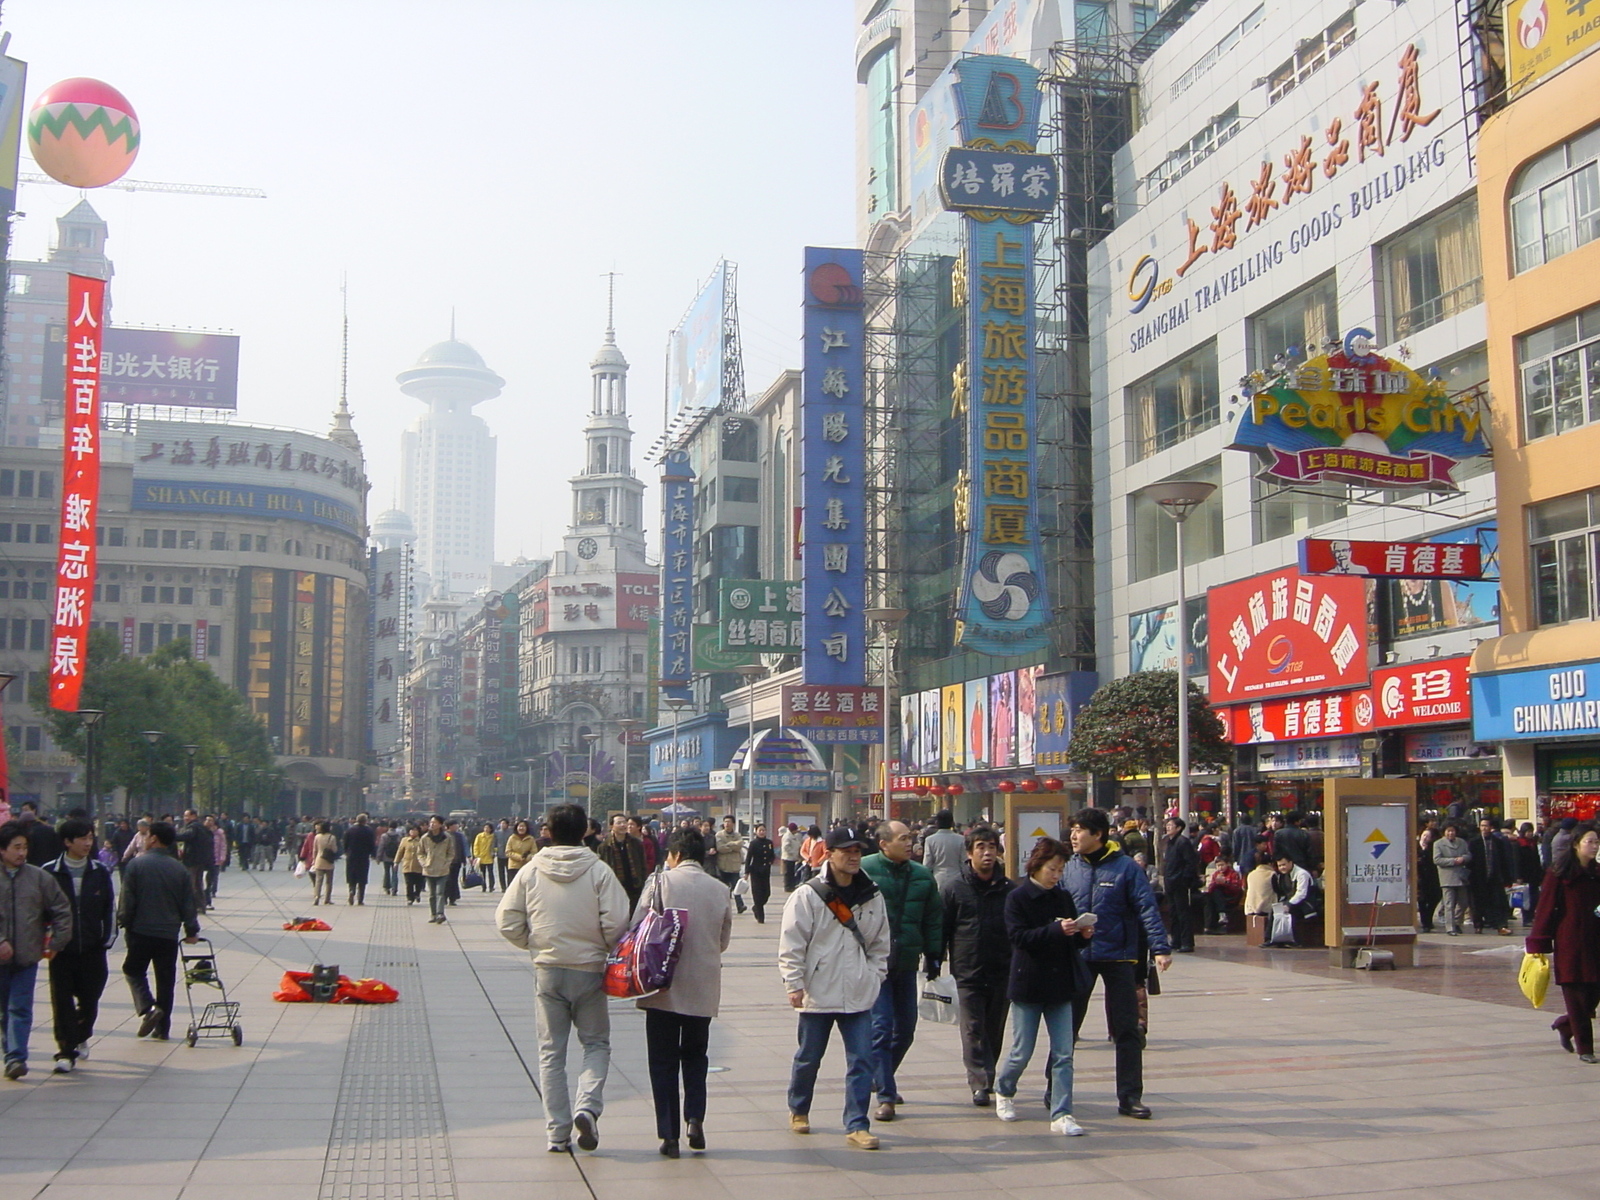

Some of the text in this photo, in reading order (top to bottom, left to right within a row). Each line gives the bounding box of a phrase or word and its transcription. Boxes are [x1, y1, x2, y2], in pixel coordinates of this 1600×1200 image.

[1130, 139, 1446, 353] SHANGHAI TRAVELLING GOODS BUILDING
[980, 232, 1031, 545] 上海旅游品商厦
[1253, 393, 1480, 442] Pearls City
[147, 486, 254, 508] SHANGHAI
[266, 494, 304, 513] HUA
[1385, 545, 1464, 574] 肯德基
[622, 585, 659, 595] TCL
[564, 602, 600, 621] 彩电
[1217, 577, 1360, 693] 上海旅游品商厦
[441, 655, 454, 726] 时装公司
[1411, 669, 1470, 701] 珍
[1550, 669, 1587, 700] GUO
[792, 691, 879, 713] 爱丝酒楼
[1284, 695, 1342, 738] 肯德基
[1413, 702, 1461, 717] WELCOME
[1447, 747, 1467, 756] CITY
[1354, 864, 1402, 877] 上海银行
